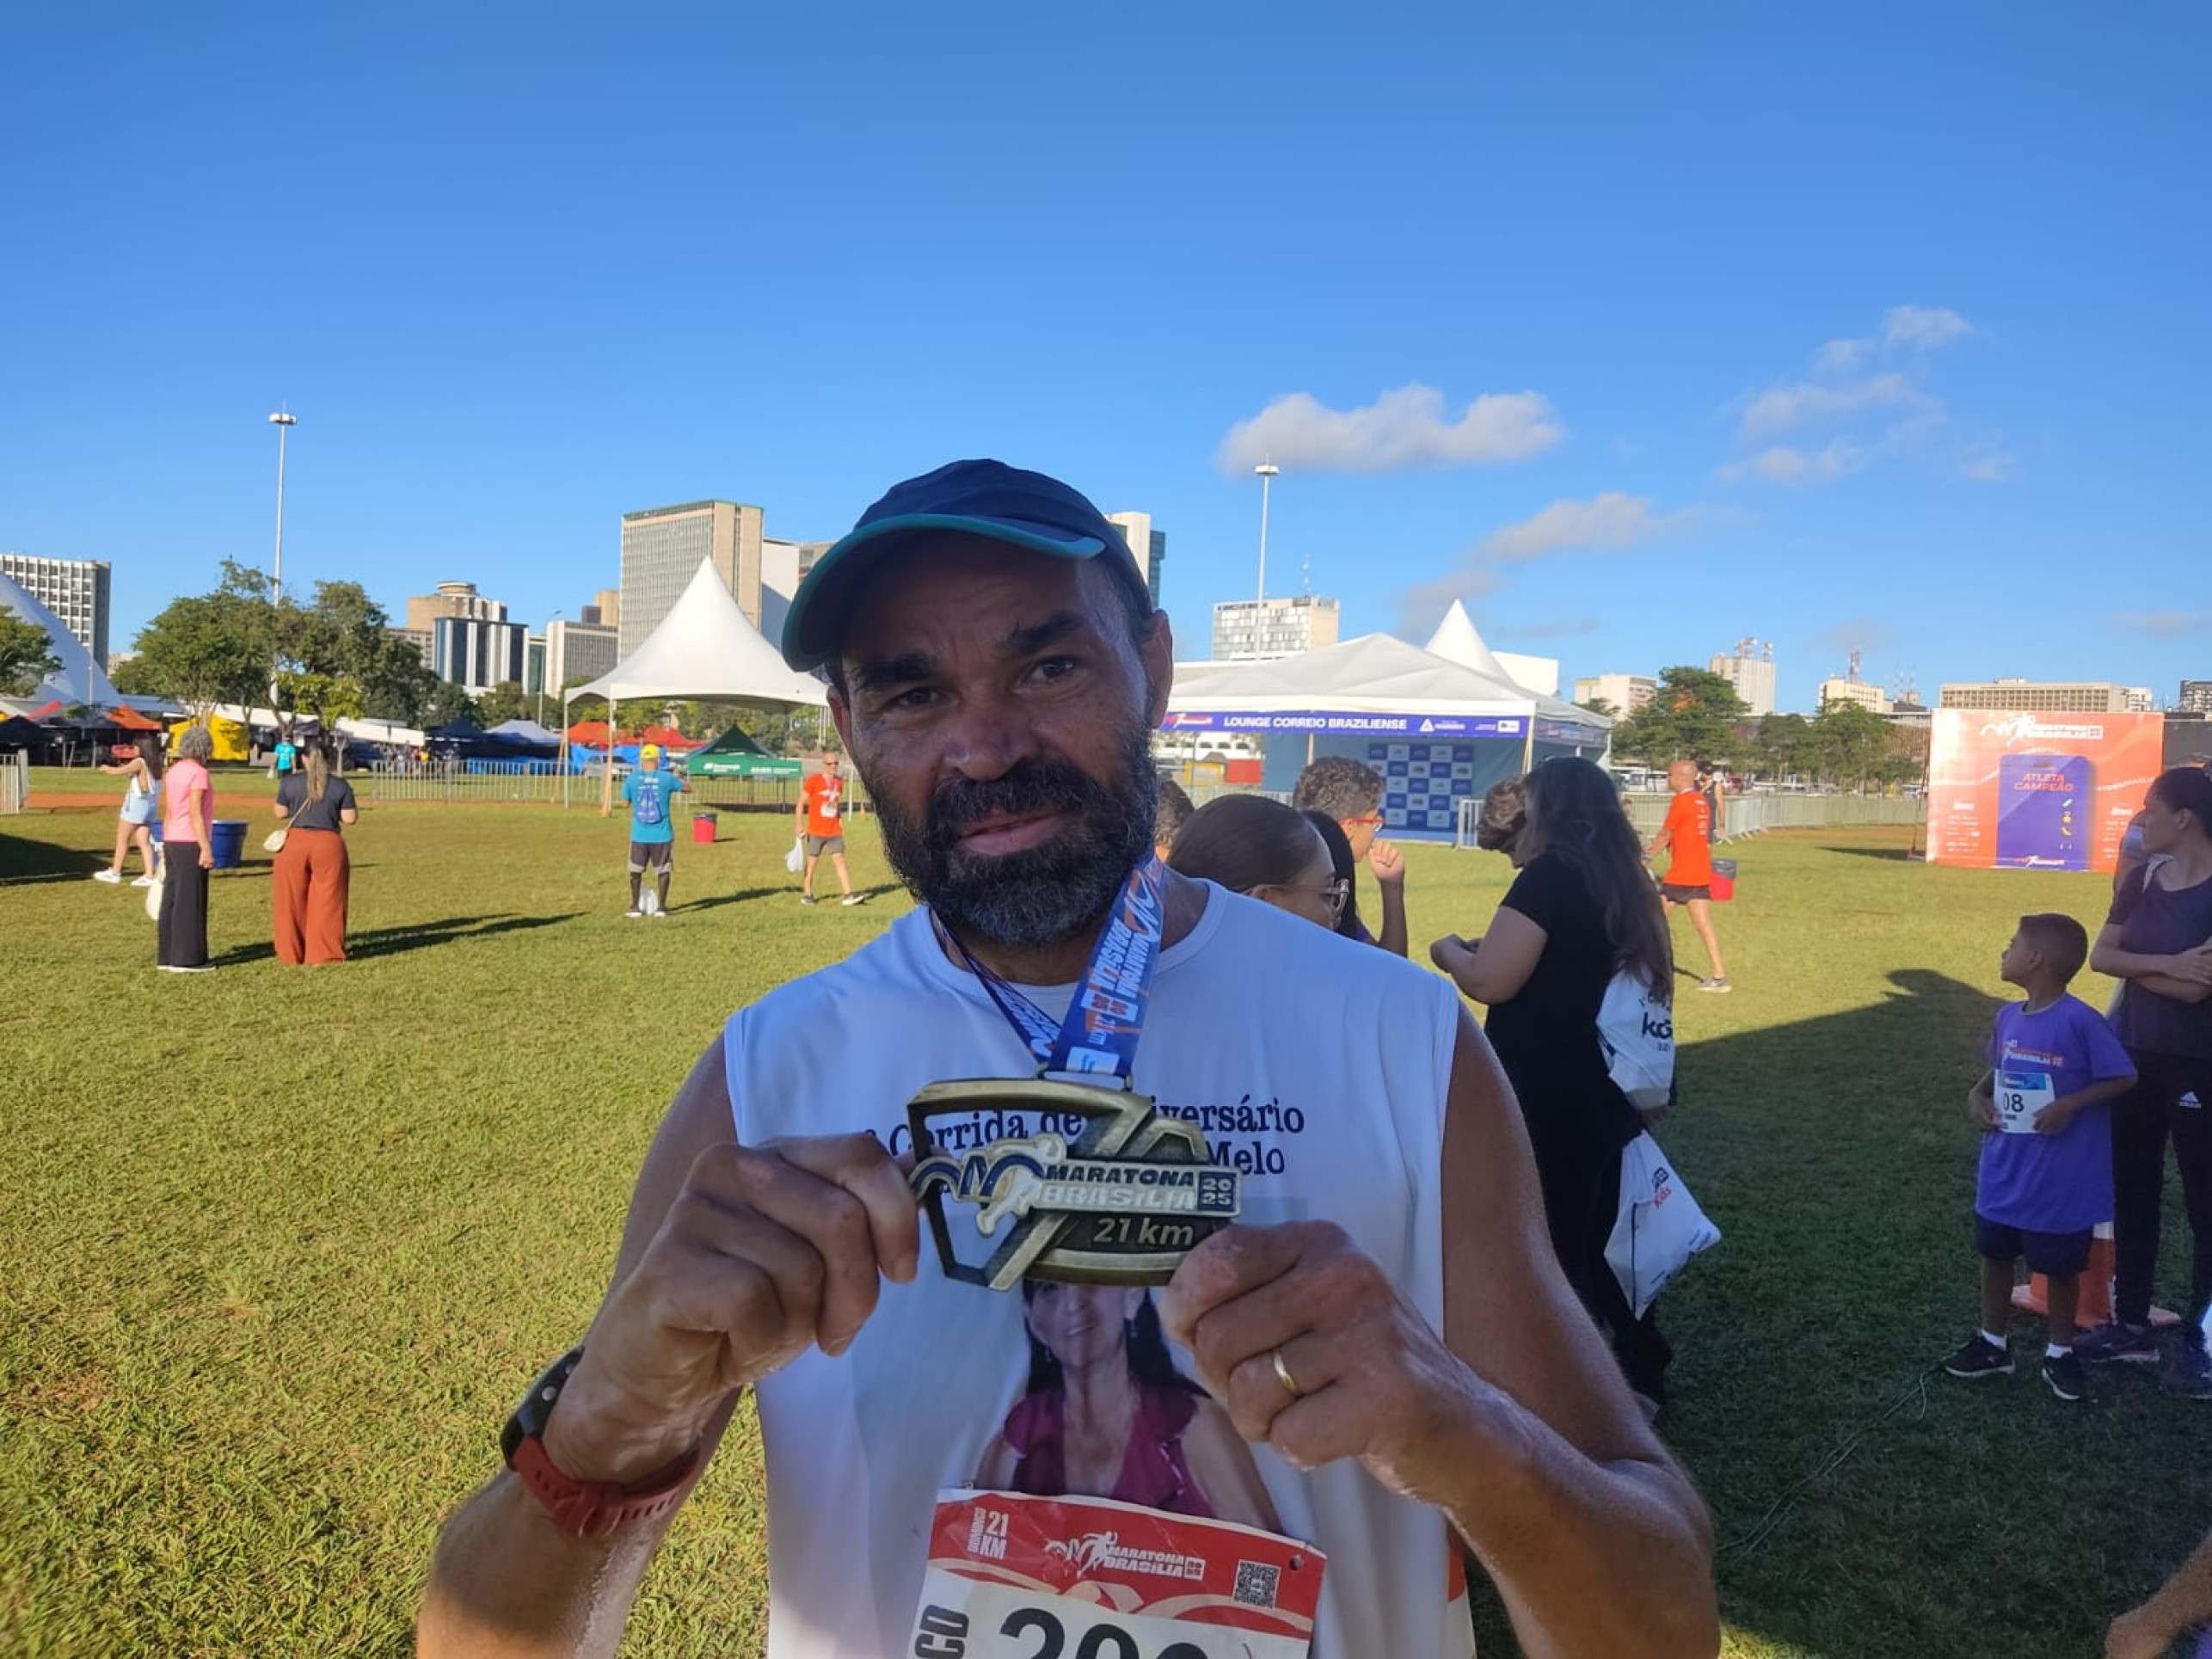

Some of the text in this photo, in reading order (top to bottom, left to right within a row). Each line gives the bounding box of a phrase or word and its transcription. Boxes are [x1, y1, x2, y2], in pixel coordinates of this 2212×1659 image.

[1224, 716, 1270, 728] LOUNGE
[1273, 716, 1325, 728] CORREIO
[1329, 716, 1408, 730] BRAZILIENSE
[2023, 773, 2065, 783] ATLETA
[889, 1109, 1029, 1157] Crrida
[1205, 1140, 1286, 1176] Melo
[1045, 1164, 1195, 1187] MARATONA
[1202, 1178, 1232, 1192] 20
[1203, 1192, 1232, 1206] 25
[1093, 1216, 1195, 1246] 21 km
[987, 1509, 1010, 1538] 21
[979, 1536, 1007, 1561] KM
[1107, 1545, 1184, 1564] MARATONA
